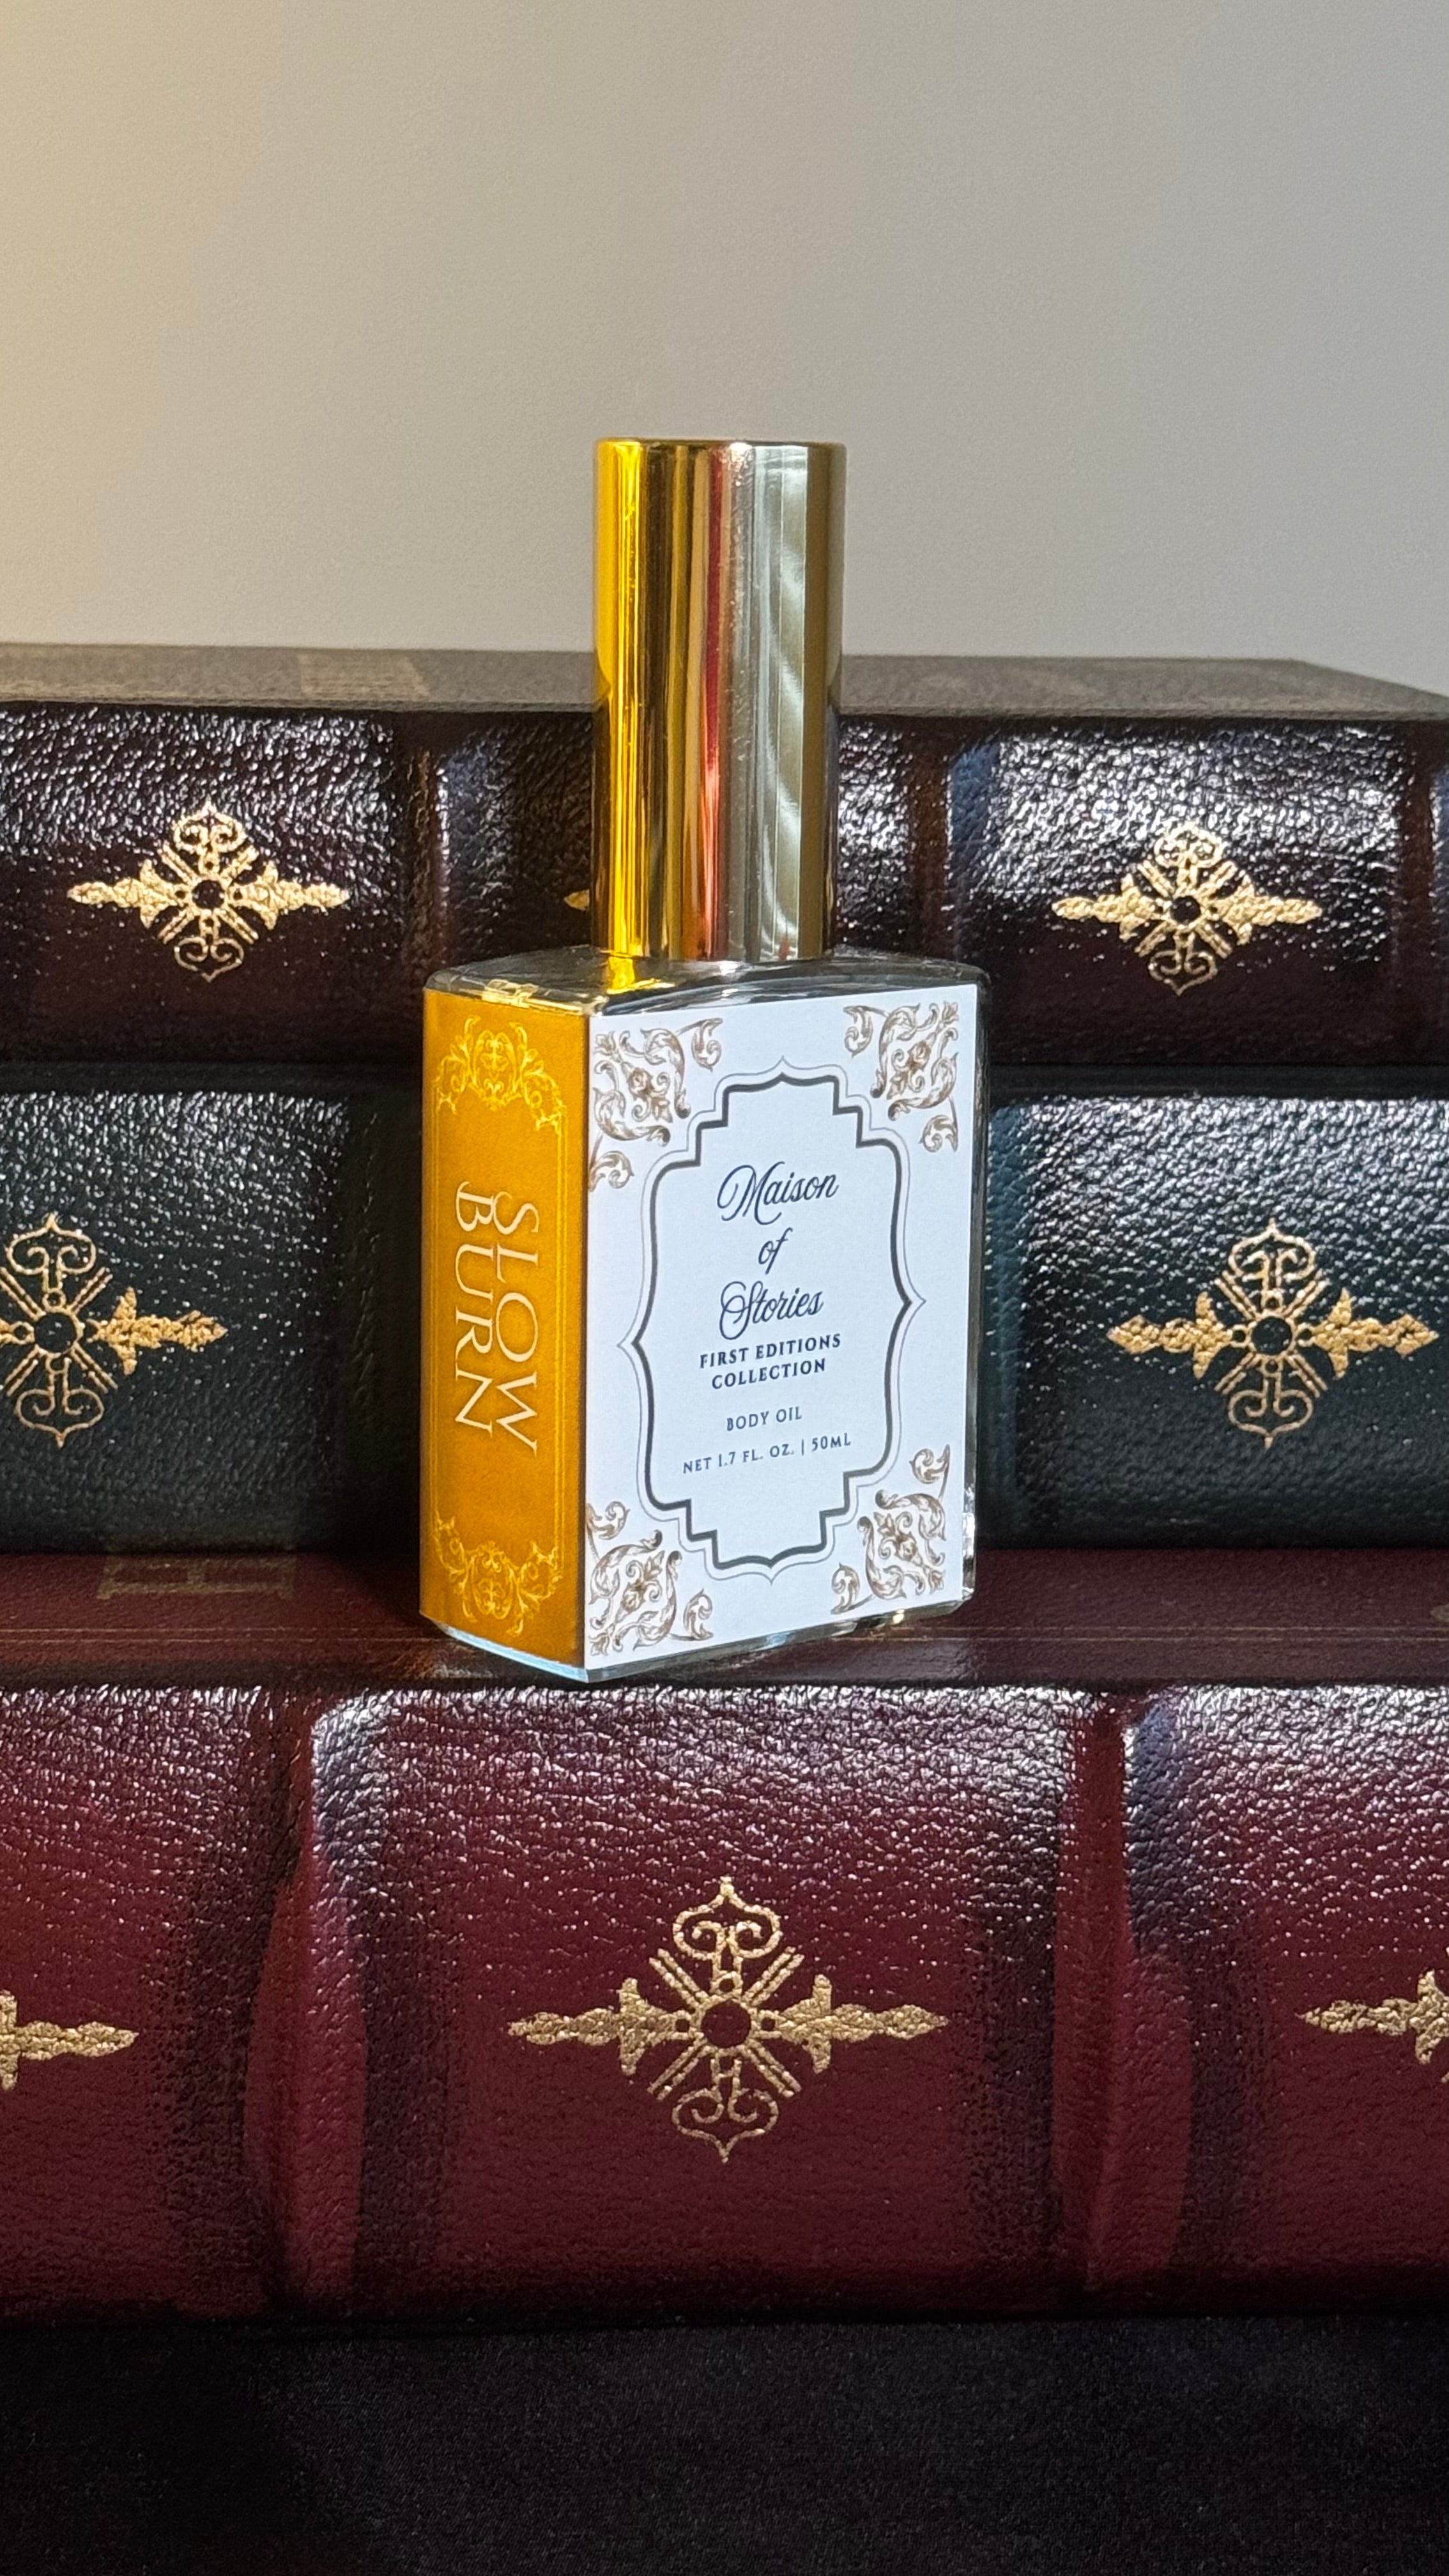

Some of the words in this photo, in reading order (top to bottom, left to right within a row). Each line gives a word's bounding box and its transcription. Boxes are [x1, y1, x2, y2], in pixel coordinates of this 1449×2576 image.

[716, 1161, 839, 1225] Maison
[758, 1227, 793, 1275] of
[454, 1181, 494, 1438] BURN
[493, 1191, 539, 1457] SLOW
[719, 1280, 824, 1340] Stories
[700, 1347, 749, 1369] FIRST
[755, 1333, 841, 1360] EDITIONS
[711, 1358, 826, 1390] COLLECTION
[726, 1410, 770, 1432] BODY
[775, 1406, 803, 1423] OIL
[682, 1456, 712, 1475] NET
[717, 1451, 737, 1468] 1.7
[742, 1448, 764, 1464] FL.
[769, 1443, 795, 1459] OZ.
[811, 1432, 852, 1452] 50ML
